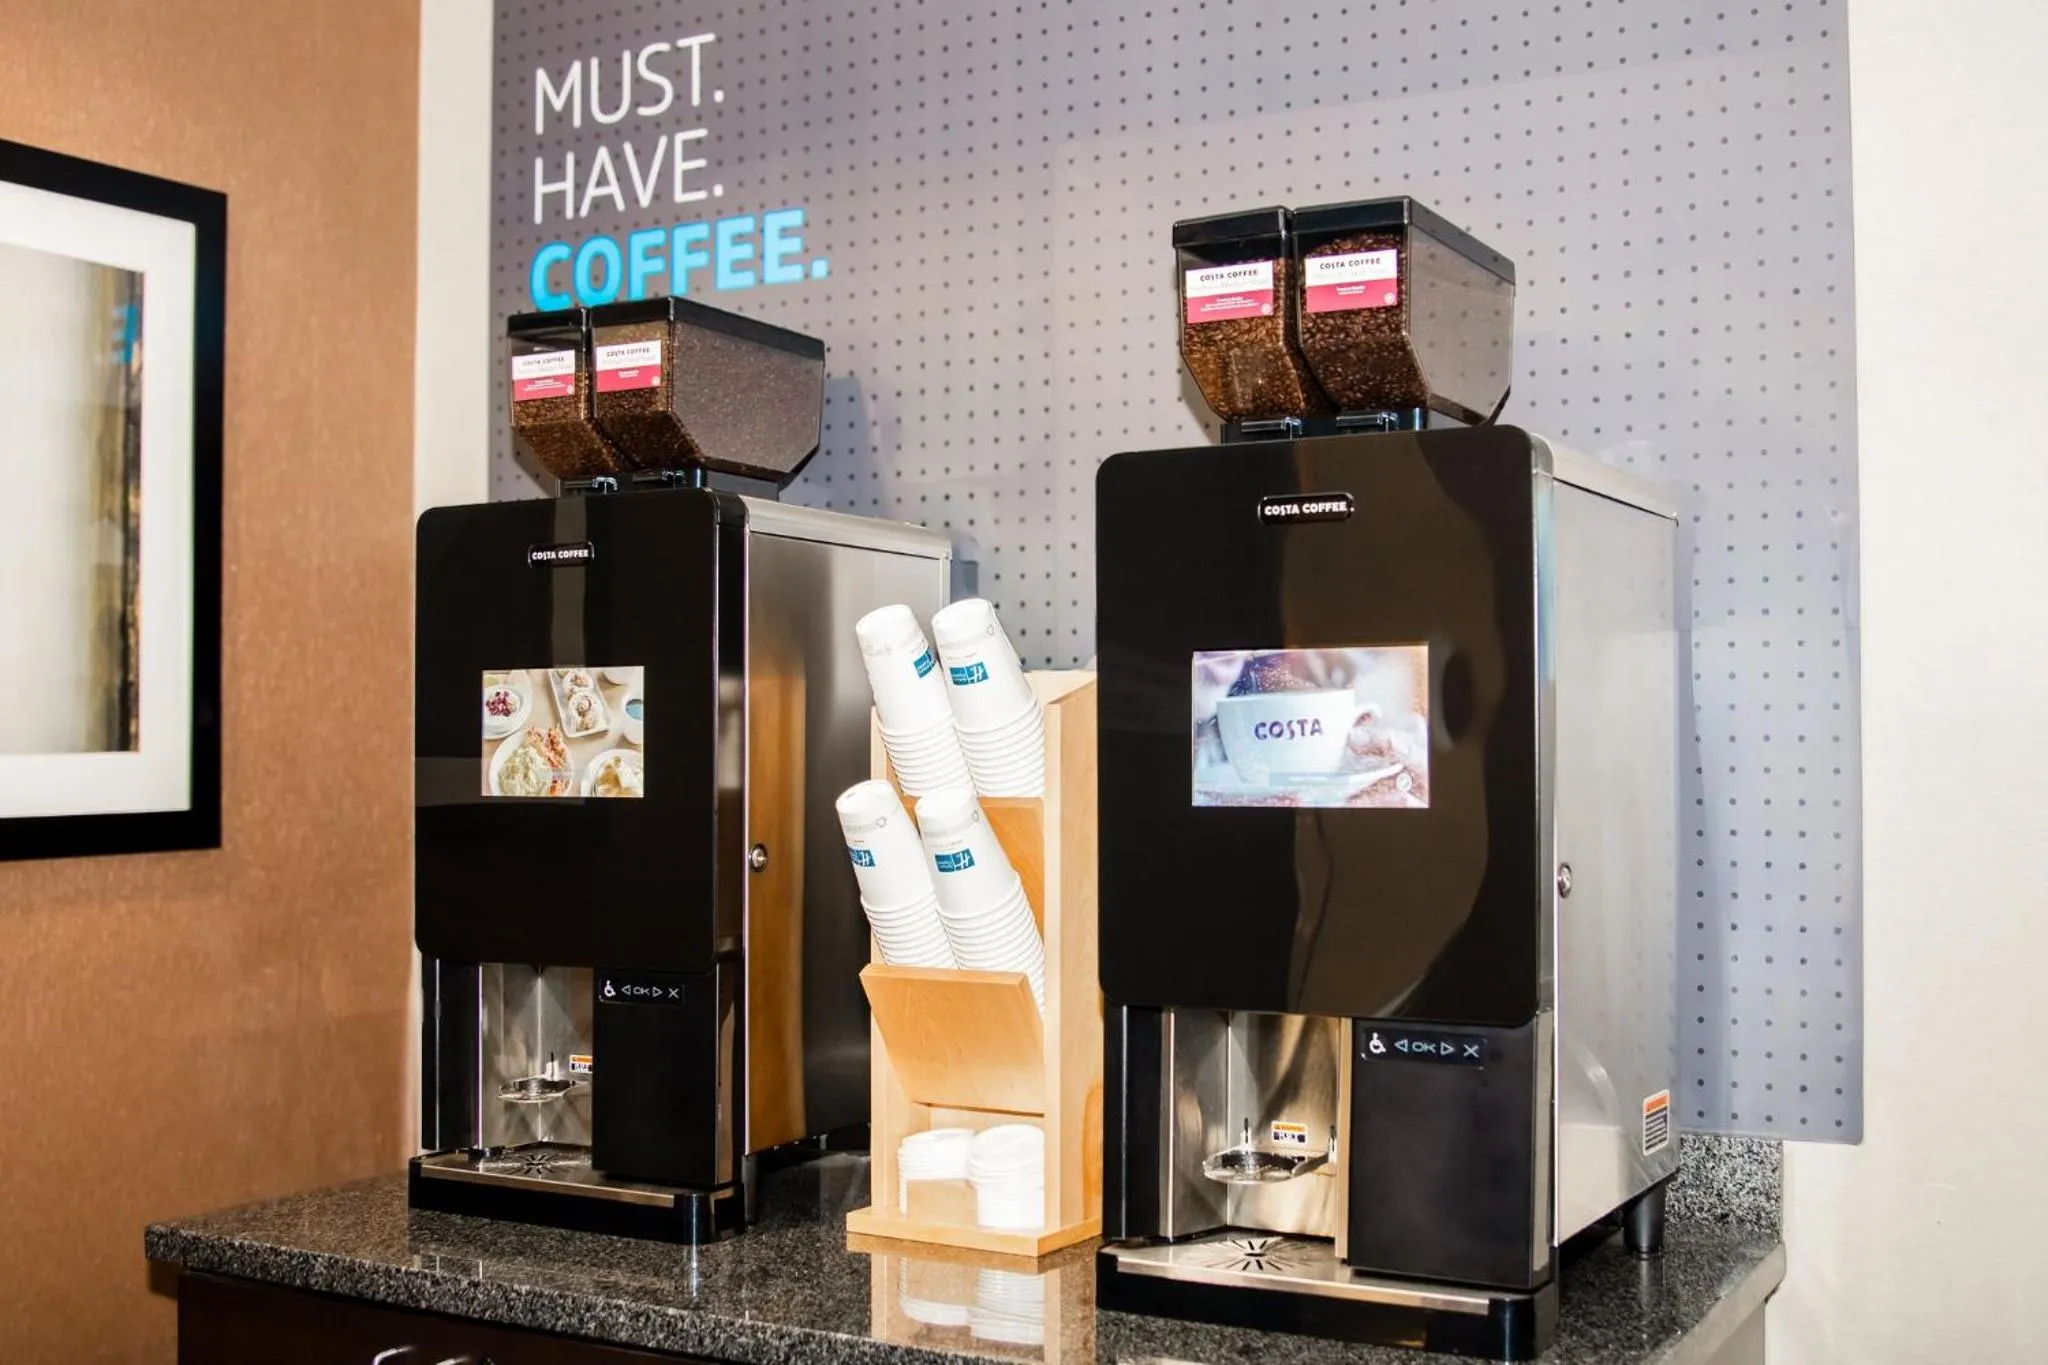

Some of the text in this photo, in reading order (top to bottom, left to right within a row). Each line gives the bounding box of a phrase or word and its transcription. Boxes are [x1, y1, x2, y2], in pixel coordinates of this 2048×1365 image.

[535, 33, 724, 135] MUST.
[534, 128, 724, 225] HAVE.
[529, 208, 828, 312] COFFEE.
[1264, 504, 1300, 516] COSTA
[531, 549, 589, 561] COSTA COFFEE
[1254, 718, 1324, 741] COSTA
[1412, 1041, 1436, 1053] OK
